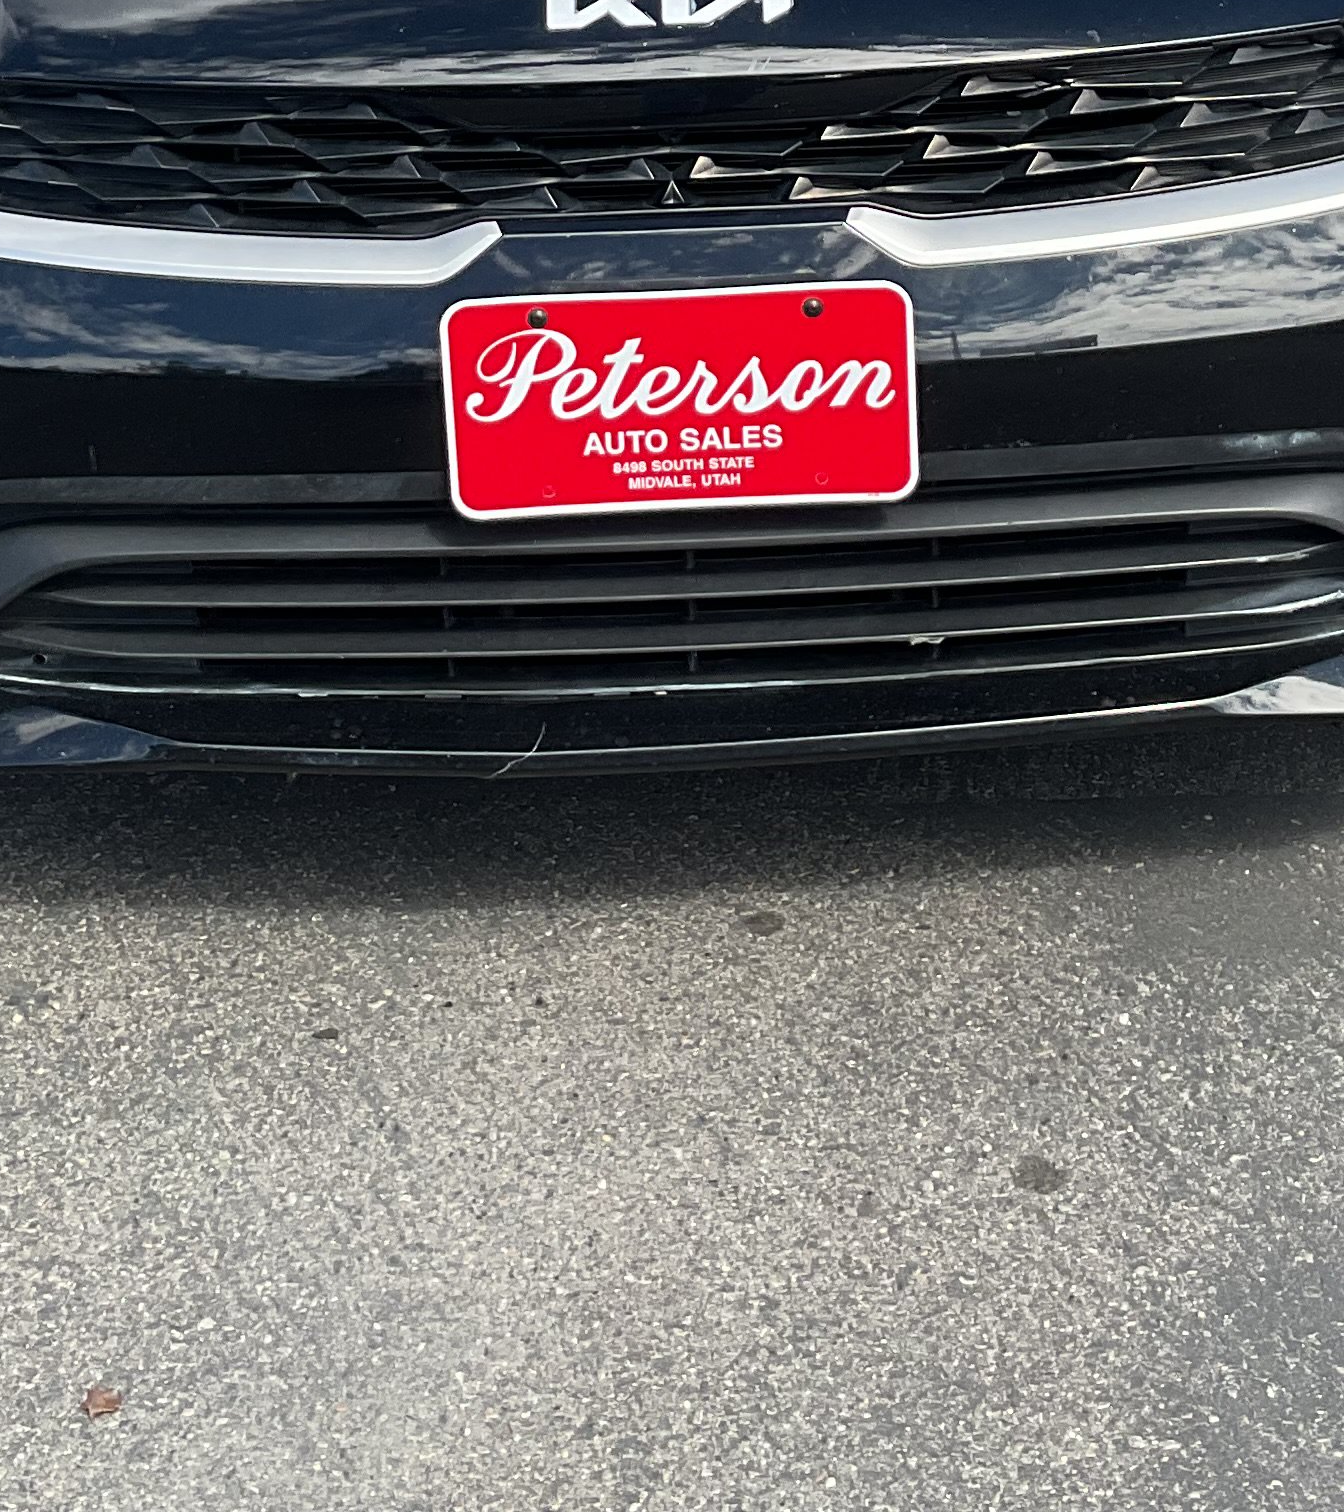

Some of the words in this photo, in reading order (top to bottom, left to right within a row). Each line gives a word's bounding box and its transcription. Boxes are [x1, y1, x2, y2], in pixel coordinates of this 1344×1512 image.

[465, 328, 896, 423] Peterson
[582, 428, 669, 456] AUTO
[679, 423, 784, 452] SALES
[612, 461, 647, 474] 8498
[651, 457, 705, 472] SOUTH
[708, 456, 755, 469] STATE
[628, 474, 697, 490] MIDVALE,
[700, 473, 741, 487] UTAH
